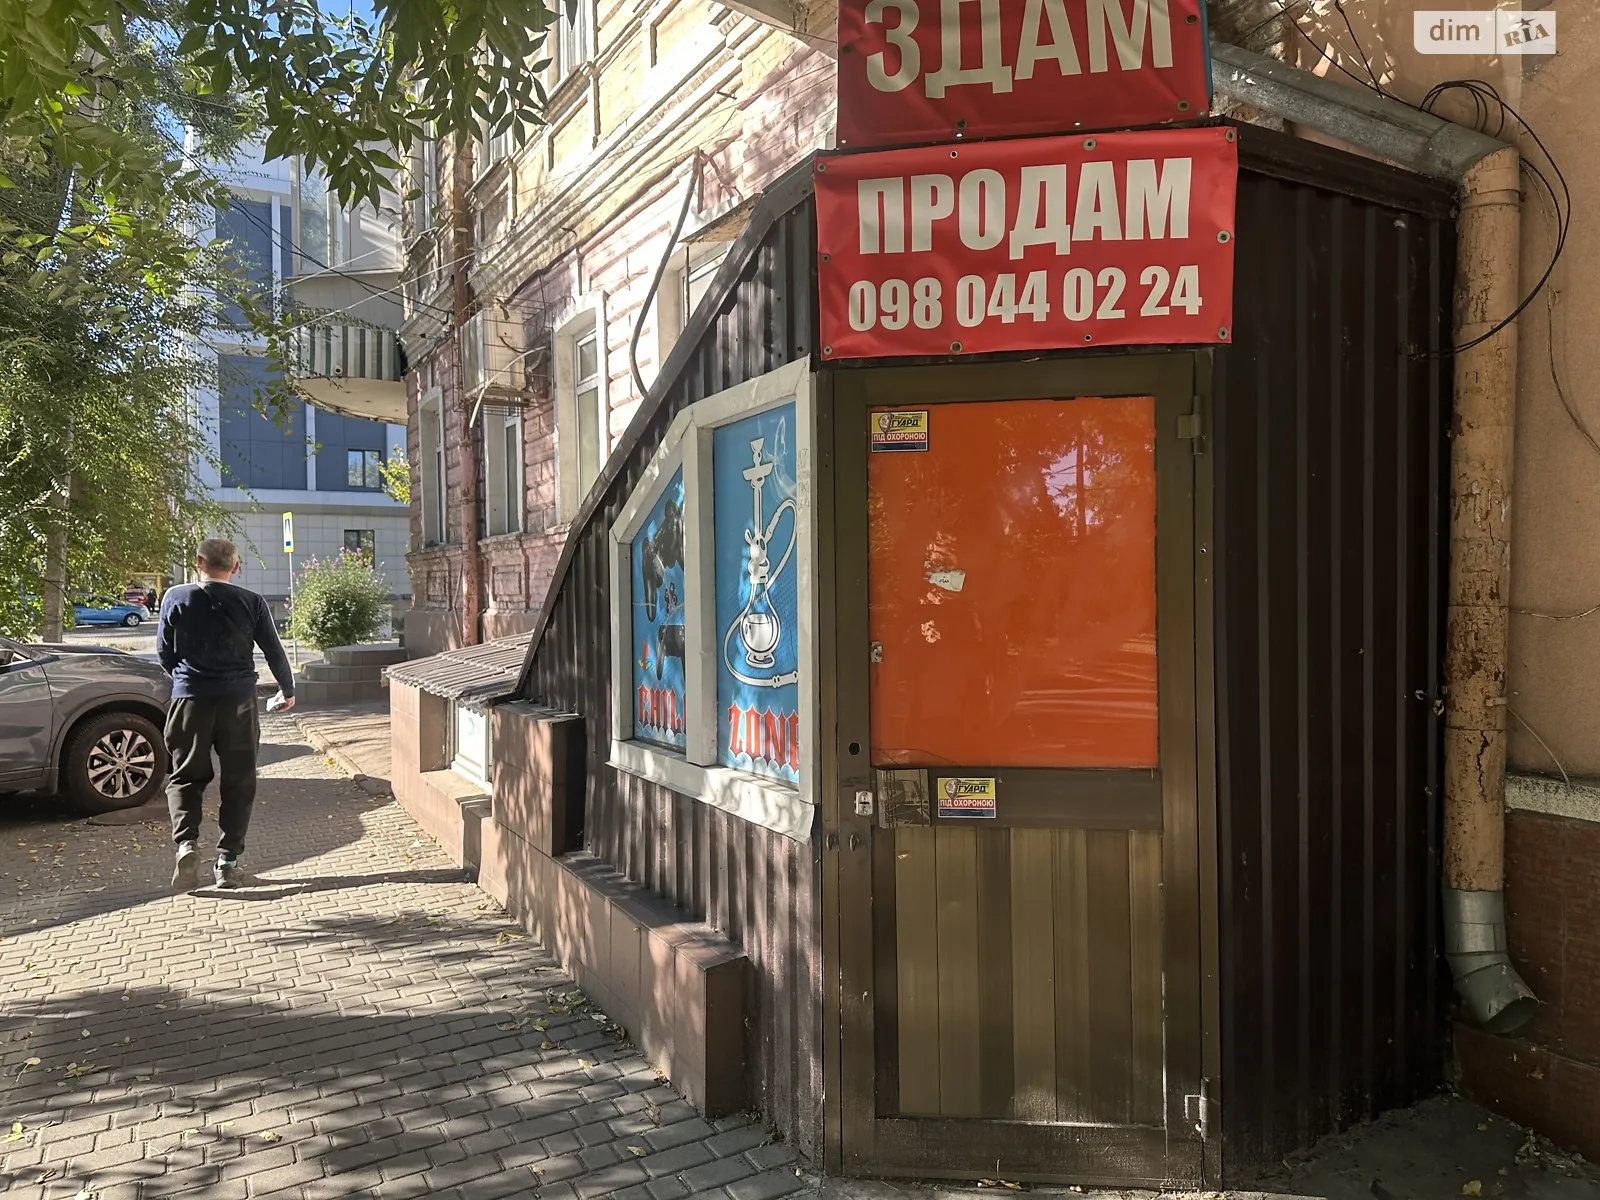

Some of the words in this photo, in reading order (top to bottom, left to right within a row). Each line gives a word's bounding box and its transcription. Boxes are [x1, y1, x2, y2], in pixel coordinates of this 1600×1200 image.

[864, 0, 1173, 99] ЗДАМ
[857, 157, 1193, 260] ПРОДАМ
[848, 277, 943, 332] 098
[955, 269, 1050, 328] 044
[1062, 266, 1127, 322] 02
[1139, 264, 1203, 318] 24
[890, 418, 919, 426] ГУАРД
[637, 683, 686, 736] CHIL
[940, 799, 952, 807] ПІД
[953, 799, 994, 807] ОХОРОНОЮ
[957, 784, 986, 793] ГУАРД
